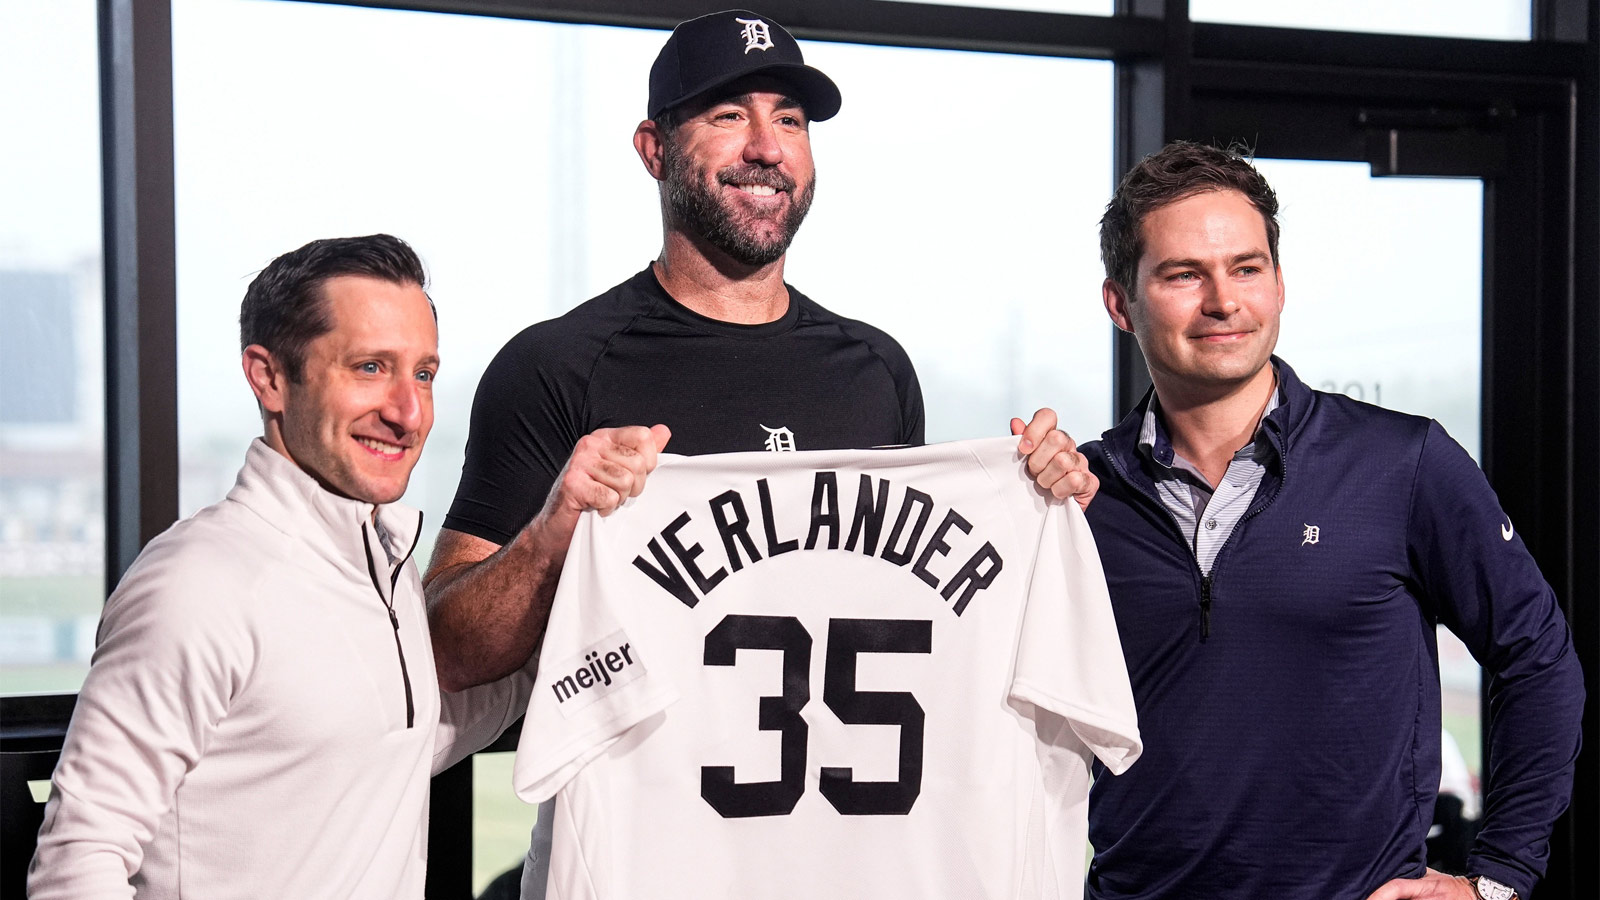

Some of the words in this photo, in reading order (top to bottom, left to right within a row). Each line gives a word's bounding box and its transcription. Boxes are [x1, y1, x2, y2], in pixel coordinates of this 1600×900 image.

[632, 471, 1003, 617] VERLANDER
[551, 642, 633, 703] meijer
[701, 614, 933, 818] 35
